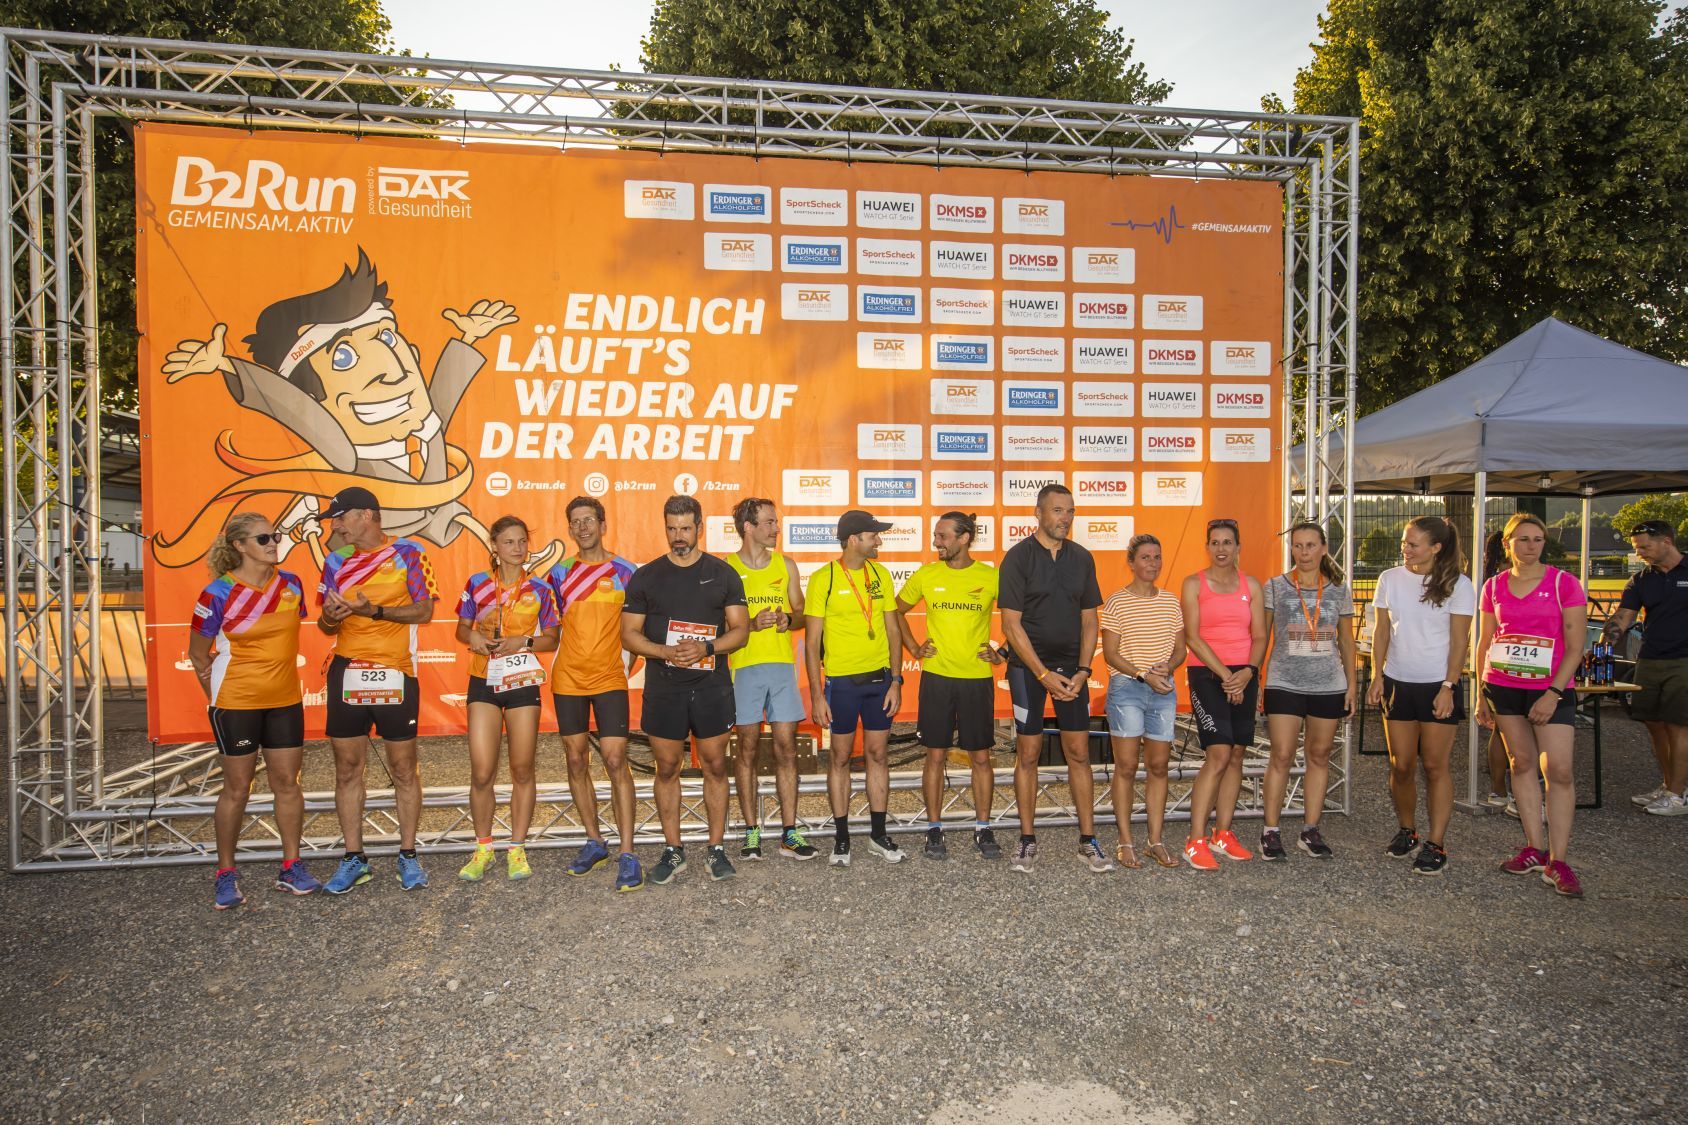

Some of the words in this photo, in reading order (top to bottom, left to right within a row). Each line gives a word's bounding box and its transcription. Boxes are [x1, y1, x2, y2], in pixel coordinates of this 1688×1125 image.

[367, 166, 374, 176] by
[171, 156, 357, 213] B2Run
[378, 167, 471, 200] DAK
[368, 178, 376, 214] powered
[642, 188, 676, 200] DAK
[714, 195, 753, 205] ERDINGER
[786, 200, 841, 208] SportScheck
[378, 198, 472, 219] Gesundheit
[863, 201, 914, 212] HUAWEI
[937, 204, 974, 218] DKMS
[1018, 204, 1048, 216] DAK
[864, 212, 888, 220] WATCH
[1192, 222, 1272, 234] #GEMEINSAMAKTIV
[722, 240, 754, 252] DAK
[791, 246, 829, 255] ERDINGER
[863, 250, 915, 259] SportScheck
[937, 251, 987, 261] HUAWEI
[1088, 254, 1118, 264] DAK
[1009, 254, 1046, 266] DKMS
[938, 262, 960, 270] WATCH
[798, 290, 830, 301] DAK
[866, 296, 904, 305] ERDINGER
[936, 300, 988, 308] SportScheck
[1009, 300, 1058, 310] HUAWEI
[1080, 303, 1116, 314] DKMS
[1158, 301, 1187, 312] DAK
[564, 293, 765, 334] ENDLICH
[874, 339, 904, 350] DAK
[940, 344, 976, 353] ERDINGER
[1080, 347, 1127, 356] HUAWEI
[1149, 349, 1184, 360] DKMS
[1226, 348, 1255, 357] DAK
[947, 386, 977, 396] DAK
[1012, 390, 1047, 399] ERDINGER
[515, 379, 695, 418] WIEDER
[704, 383, 797, 419] AUF
[1149, 392, 1196, 401] HUAWEI
[1217, 393, 1252, 404] DKMS
[874, 430, 905, 441] DAK
[940, 435, 977, 444] ERDINGER
[1080, 435, 1127, 444] HUAWEI
[1225, 434, 1254, 444] DAK
[480, 421, 574, 459] DER
[583, 423, 754, 461] ARBEIT
[1149, 437, 1184, 447] DKMS
[517, 480, 566, 490] b2run.de
[614, 481, 656, 491] @b2run
[703, 481, 740, 491] /b2run
[800, 476, 831, 487] DAK
[867, 480, 904, 489] ERDINGER
[1080, 481, 1115, 491] DKMS
[1157, 478, 1186, 488] DAK
[792, 526, 831, 535] ERDINGER
[1009, 526, 1039, 536] DKM
[1088, 522, 1118, 532] DAK
[748, 596, 784, 604] RUNNER
[932, 602, 982, 611] K-RUNNER
[1505, 645, 1538, 658] 1214
[506, 655, 528, 668] 537
[361, 670, 386, 682] 523
